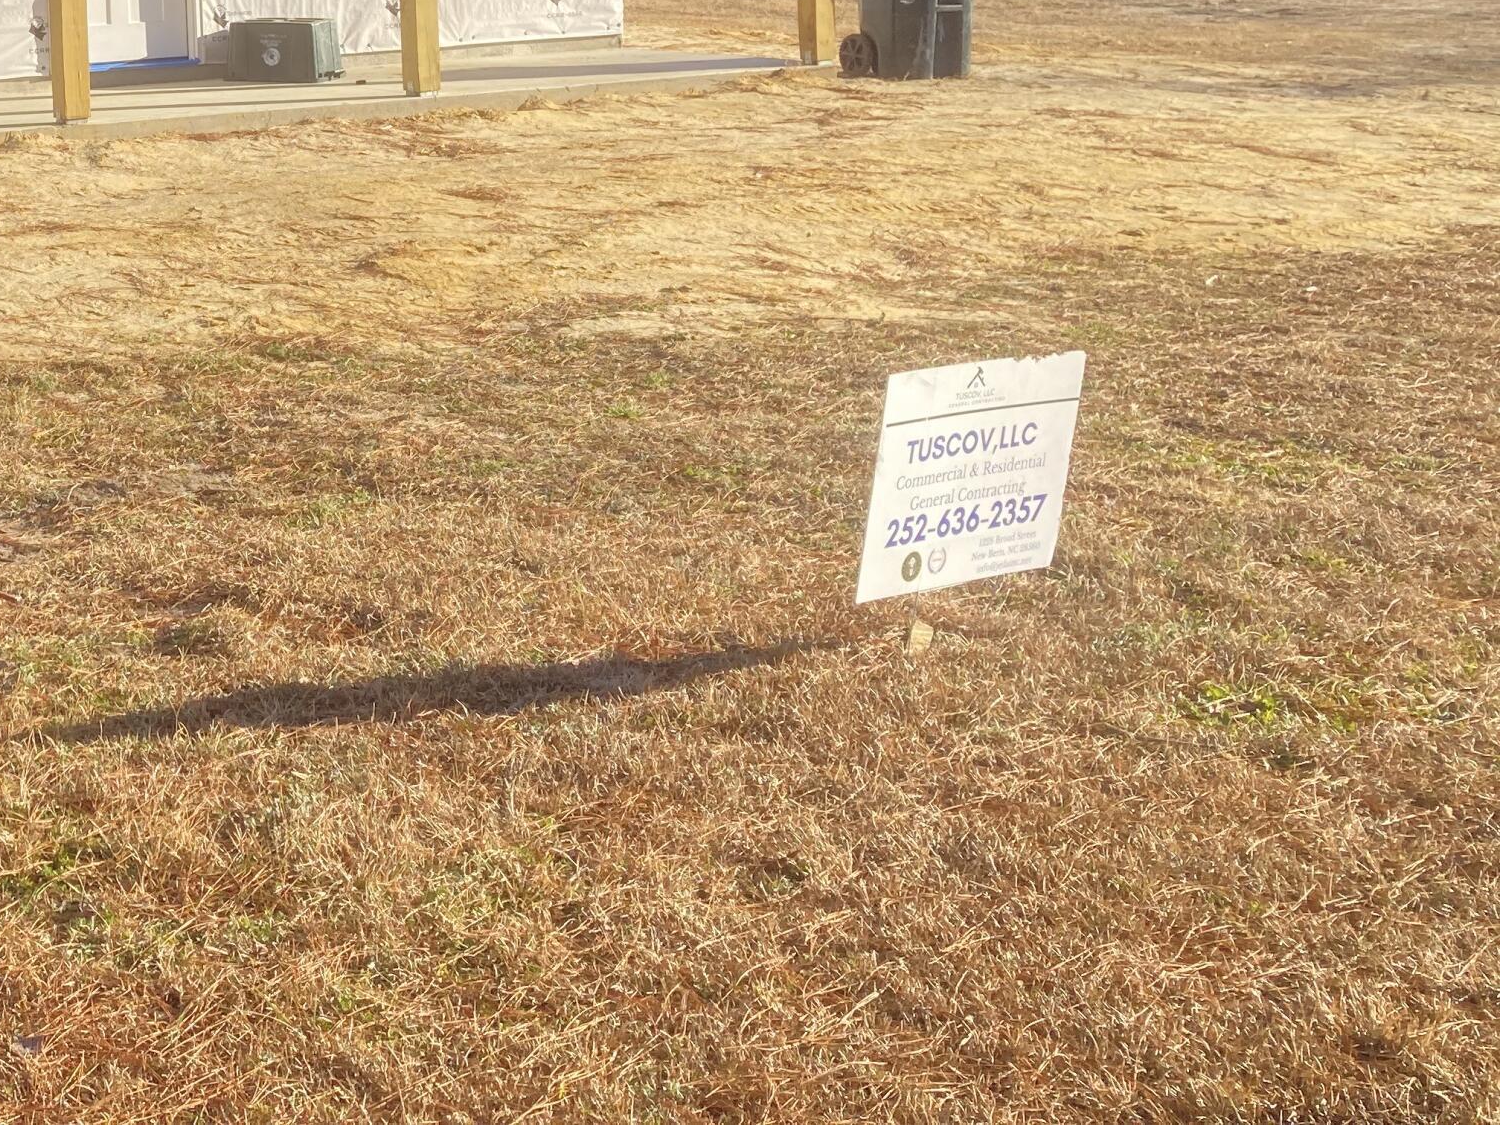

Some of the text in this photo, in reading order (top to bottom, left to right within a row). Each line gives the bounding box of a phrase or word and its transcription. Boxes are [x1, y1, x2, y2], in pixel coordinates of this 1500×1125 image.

[896, 452, 1047, 491] Commercial & Residential
[910, 480, 1028, 511] General Contracting
[884, 493, 1049, 548] 252-636-2357
